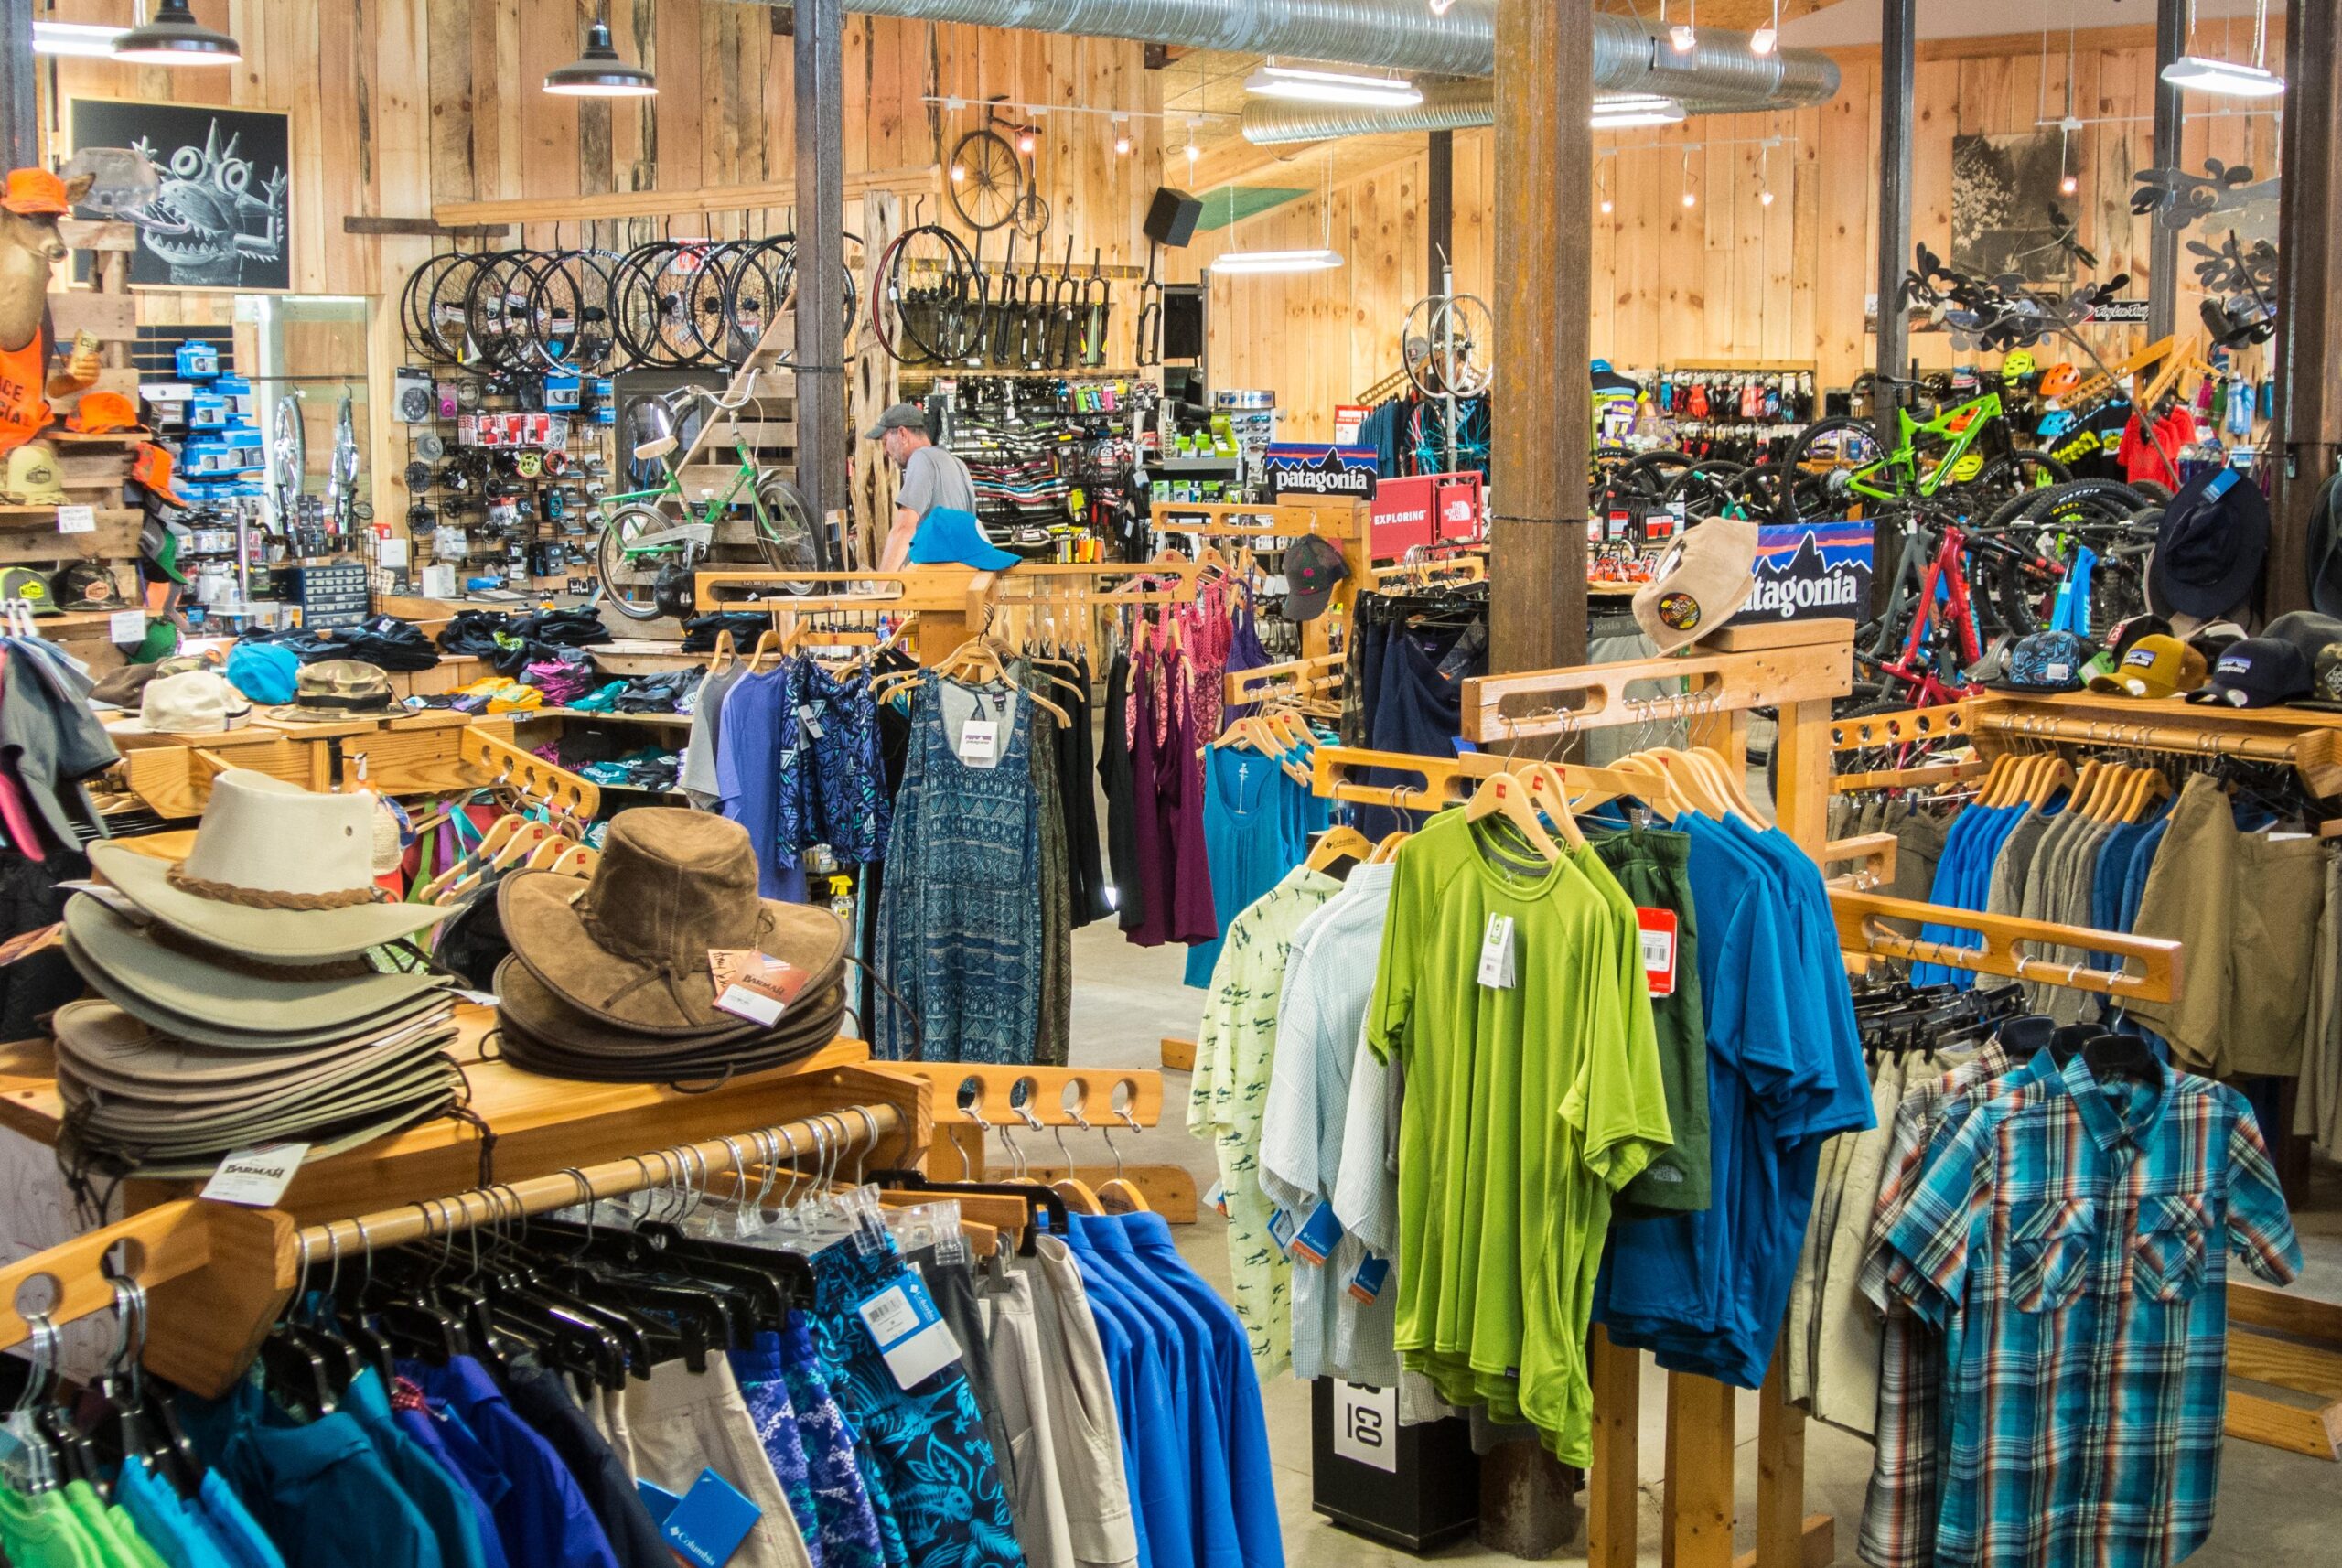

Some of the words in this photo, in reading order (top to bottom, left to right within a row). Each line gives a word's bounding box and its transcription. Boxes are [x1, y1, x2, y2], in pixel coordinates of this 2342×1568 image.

[1275, 469, 1368, 493] patagonia
[1374, 510, 1426, 526] EXPLORING
[1738, 569, 1858, 618] tagonia
[224, 1164, 285, 1179] BARMAH
[916, 1290, 936, 1322] Columbia
[677, 1532, 716, 1567] Columbia
